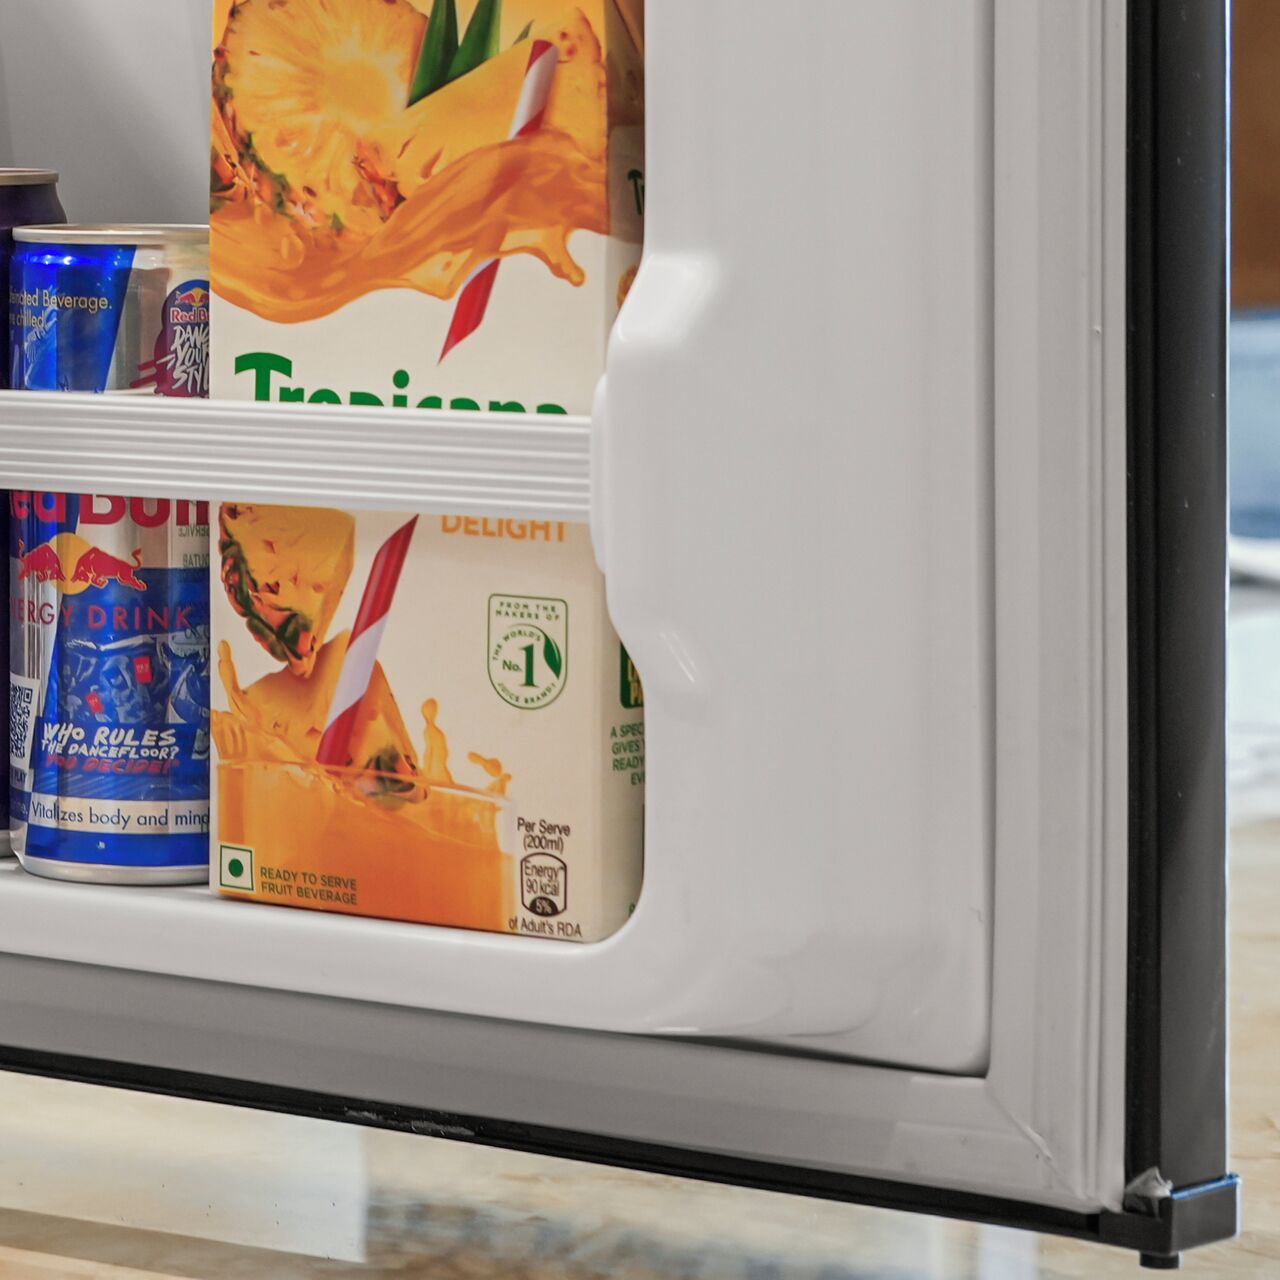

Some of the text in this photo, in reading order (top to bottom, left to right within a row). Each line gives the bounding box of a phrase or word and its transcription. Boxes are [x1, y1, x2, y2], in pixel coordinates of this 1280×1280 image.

[170, 307, 197, 324] Red
[171, 365, 209, 394] STYL
[10, 597, 193, 630] NERGY DRINK
[495, 609, 539, 620] MAKERS
[500, 601, 556, 613] FROM THE
[518, 643, 541, 688] 1
[43, 722, 177, 747] WHO RULES
[610, 725, 617, 738] A
[41, 739, 180, 760] THE DANCEFLOOR?
[612, 739, 640, 755] GIVES
[31, 800, 84, 822] Vitalizes
[90, 806, 131, 830] body
[137, 808, 168, 826] and
[517, 816, 571, 837] Per Serve
[523, 834, 564, 855] (200ml)
[260, 866, 357, 891] READY TO SERVE
[526, 878, 560, 896] 90 kcal
[261, 881, 358, 905] FRUIT BEVERAGE
[508, 917, 583, 938] of Adult's RDA
